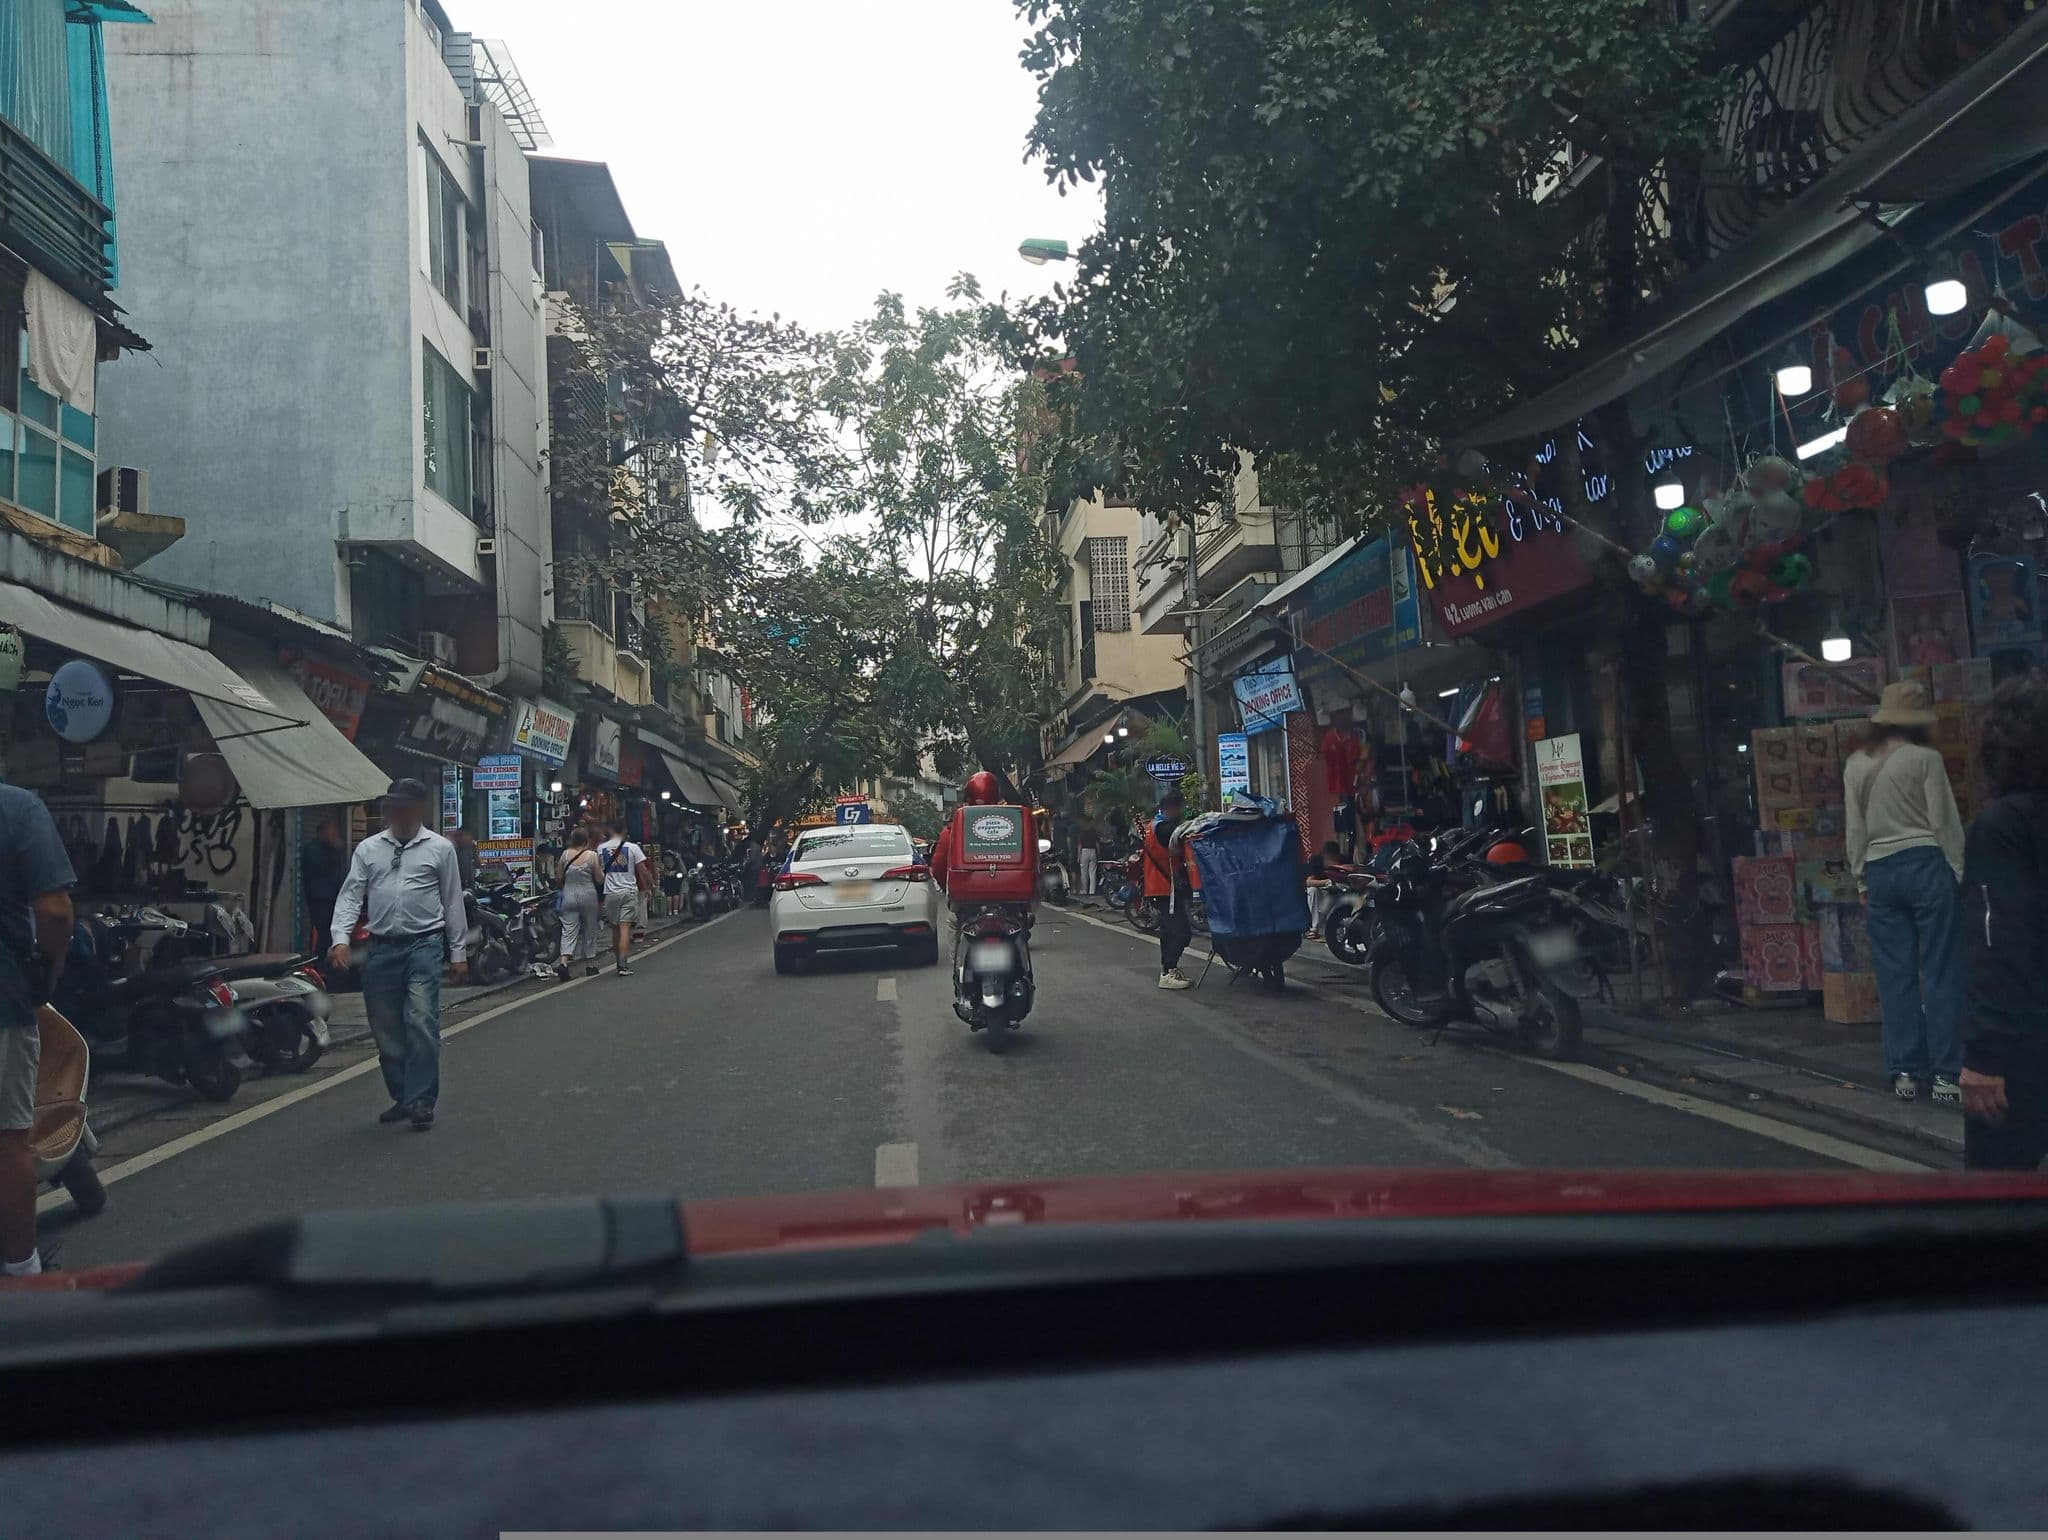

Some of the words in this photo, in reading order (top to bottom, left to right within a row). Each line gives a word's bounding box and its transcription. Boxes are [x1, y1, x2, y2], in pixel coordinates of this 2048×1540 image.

[1444, 602, 1462, 626] 42
[1245, 692, 1271, 715] BOOKING
[1270, 683, 1292, 705] OFFICE
[531, 735, 550, 752] BOOKING
[549, 741, 565, 756] OFFICE
[501, 755, 520, 765] OFFICE
[1148, 763, 1154, 772] LA
[1155, 763, 1170, 771] BELLE
[1171, 762, 1179, 771] VIE
[844, 807, 861, 824] G7
[477, 840, 508, 850] BOOKING
[509, 840, 531, 848] OFFICE
[479, 849, 500, 858] MONEY
[500, 849, 530, 857] EXCHANGE
